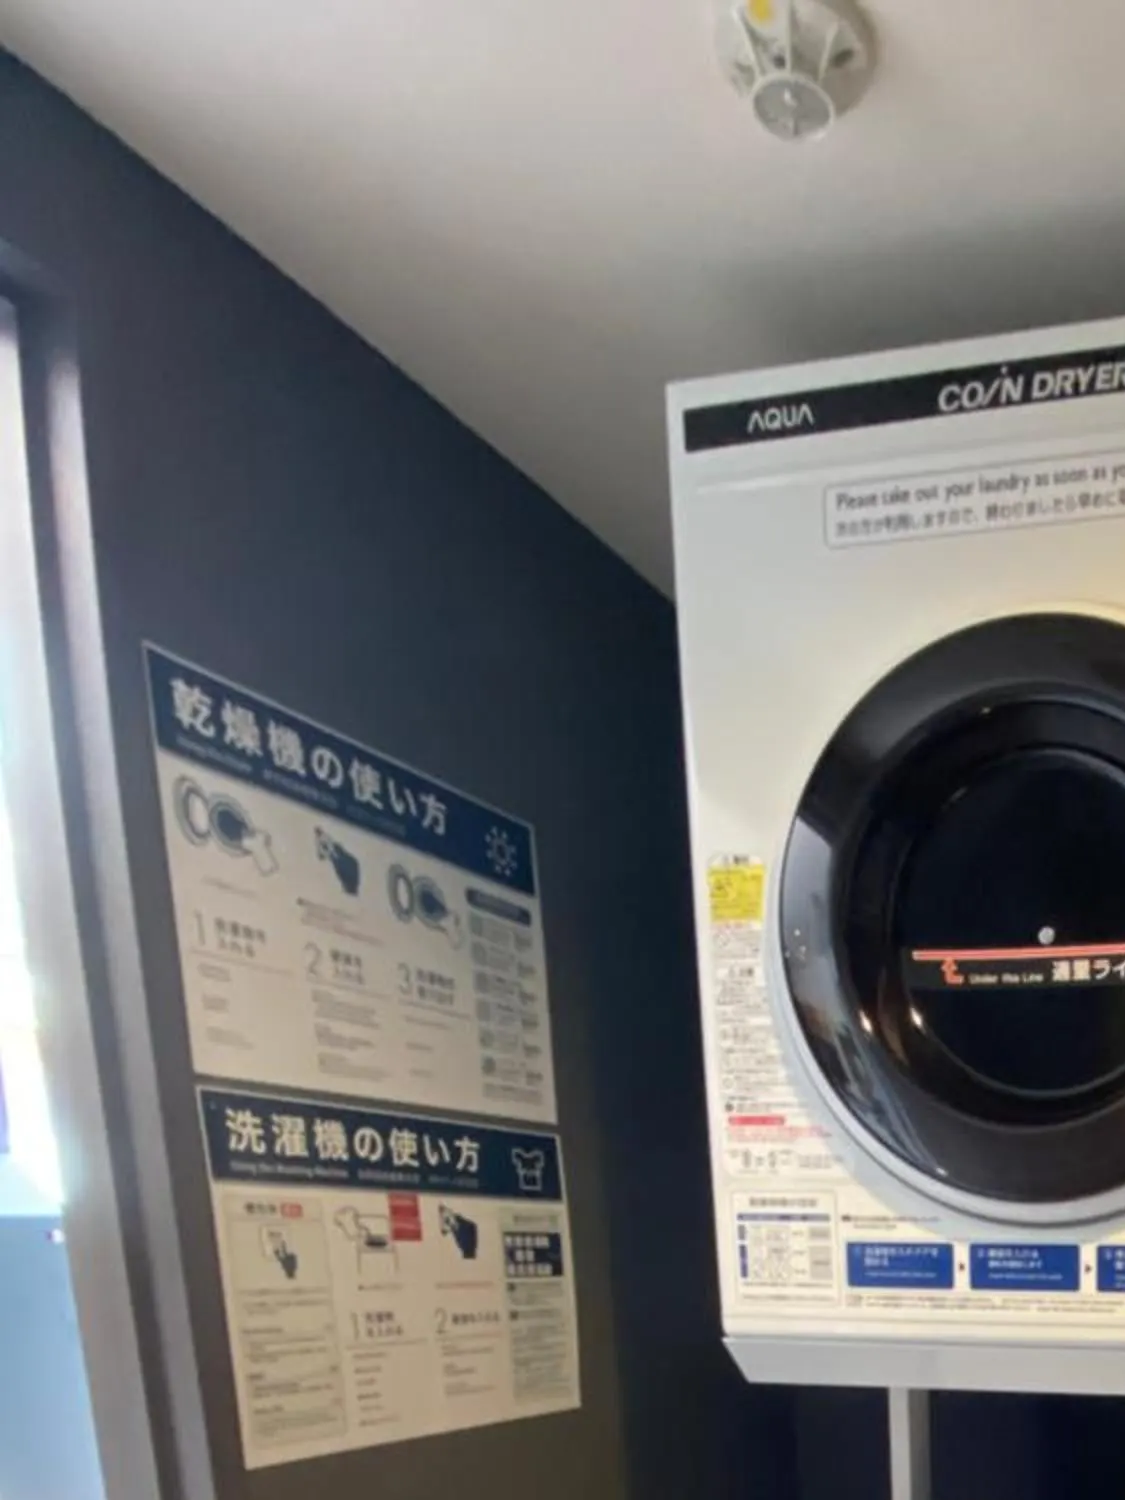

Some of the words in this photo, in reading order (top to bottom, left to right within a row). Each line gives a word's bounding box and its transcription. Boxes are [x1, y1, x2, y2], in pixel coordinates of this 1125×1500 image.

[938, 366, 1024, 412] COIN
[748, 403, 815, 434] AQUA
[914, 485, 938, 502] out
[944, 481, 973, 503] your
[978, 472, 1030, 494] laundry
[170, 677, 447, 835] 乾燥機の使い方
[225, 1107, 481, 1173] 洗濯機の使い方
